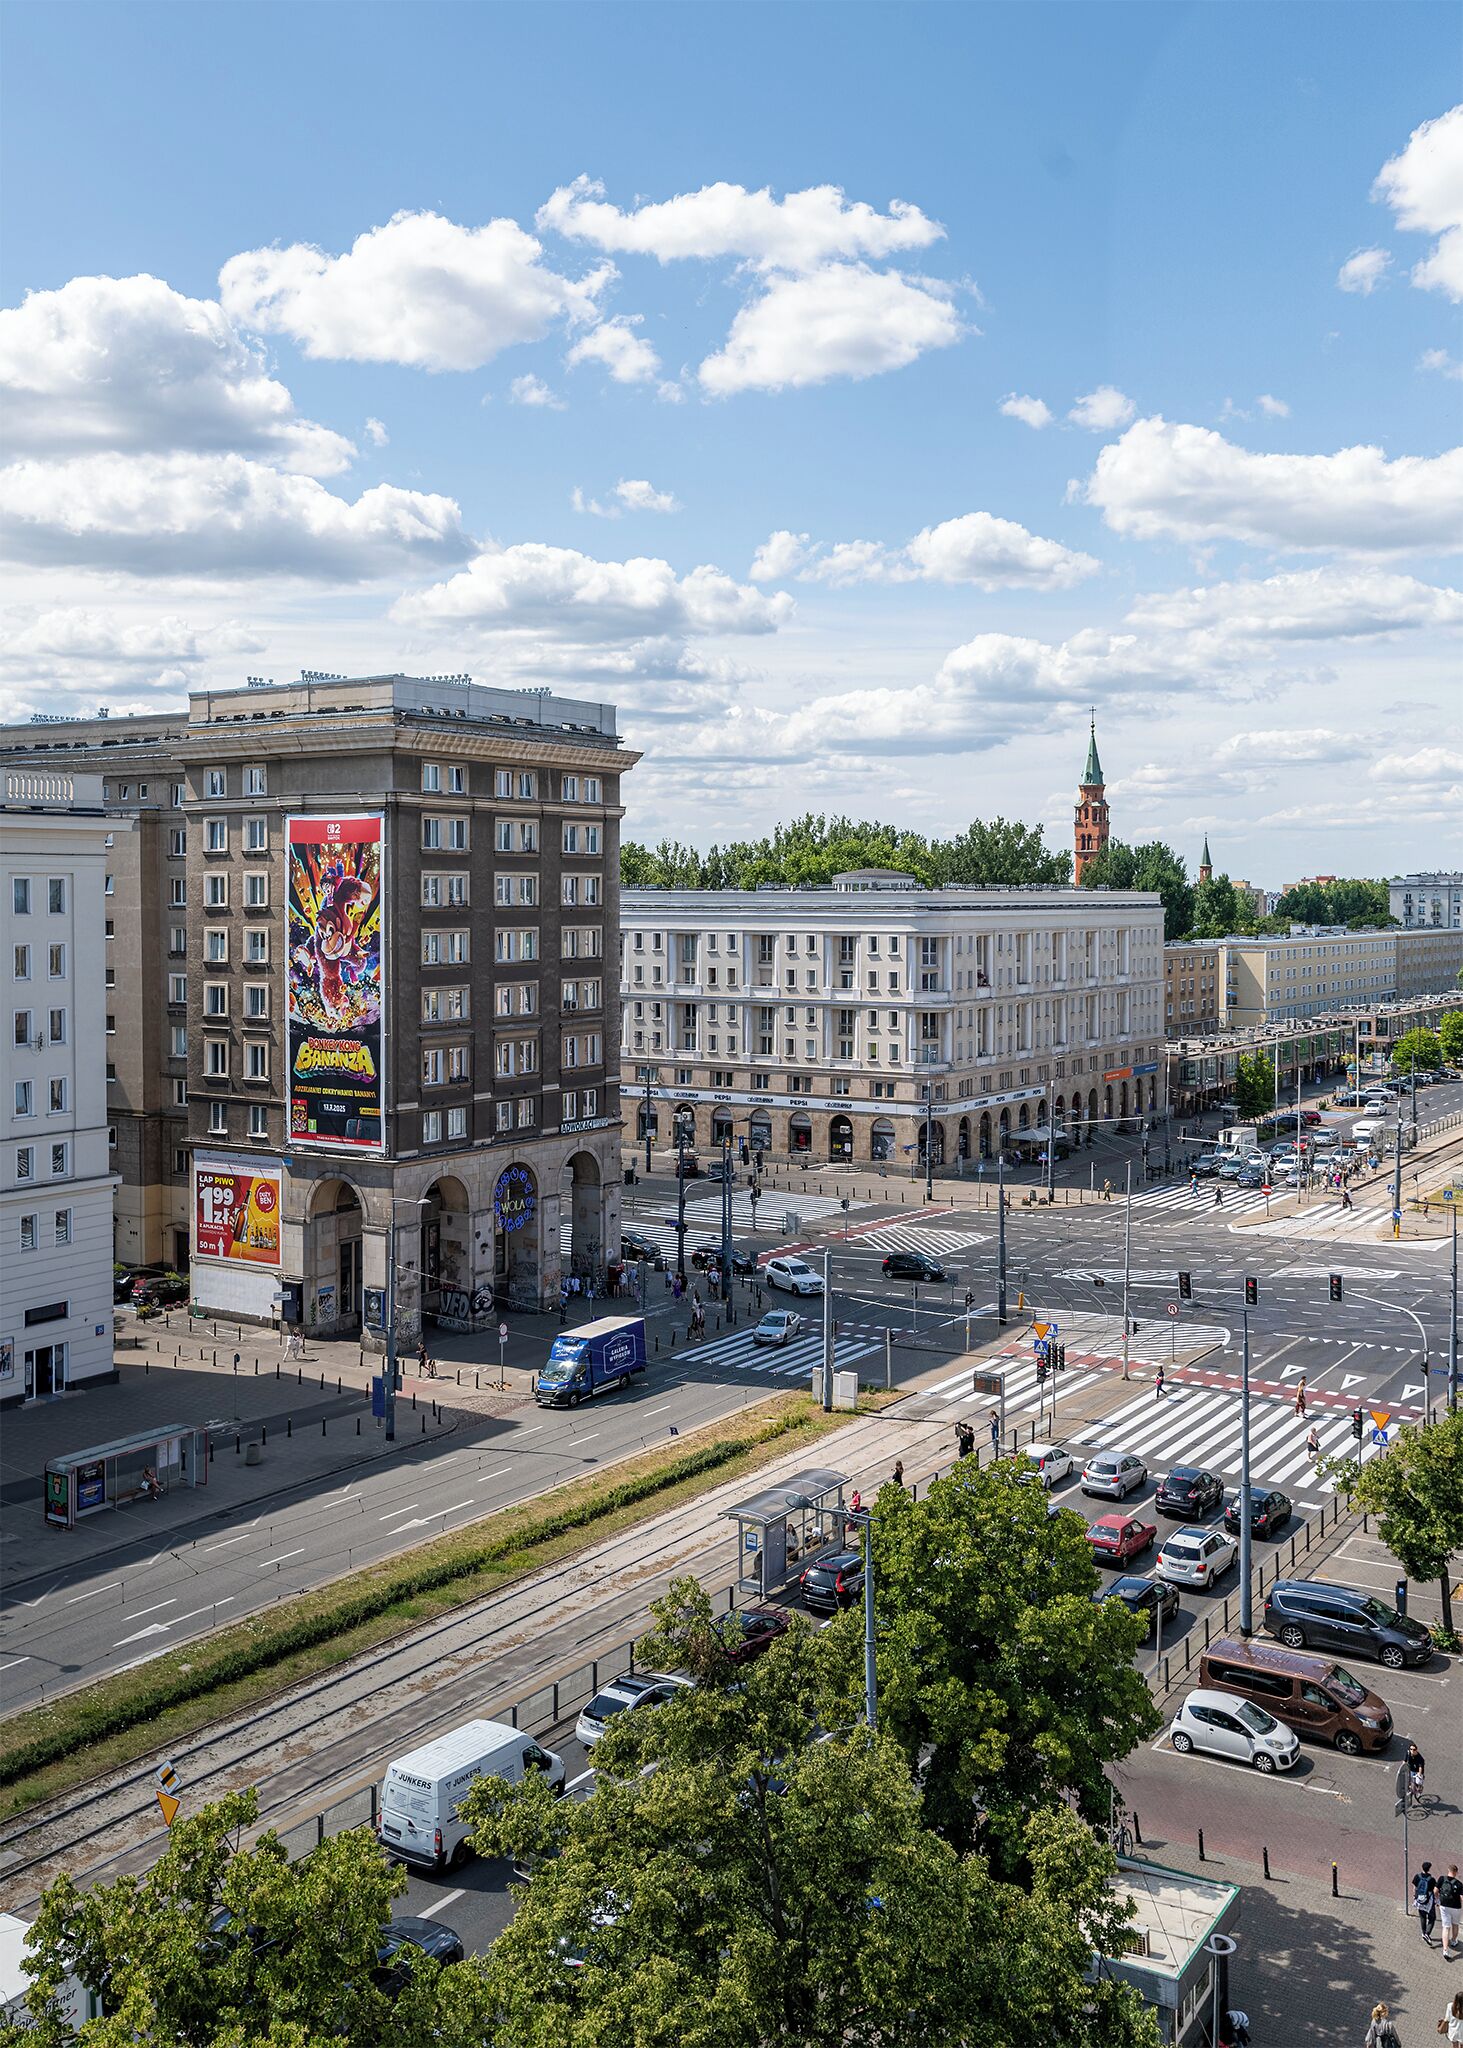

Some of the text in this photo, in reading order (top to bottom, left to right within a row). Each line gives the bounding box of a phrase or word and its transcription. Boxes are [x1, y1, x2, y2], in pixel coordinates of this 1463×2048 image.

[308, 1036, 361, 1052] DONKEY KONG
[296, 1042, 375, 1077] BANANZA
[789, 1099, 808, 1107] PEPSI
[199, 1174, 235, 1186] ŁAP PIWO
[501, 1199, 526, 1214] WOLA
[200, 1240, 208, 1249] 50
[398, 1773, 432, 1790] JUNKERS
[453, 1766, 481, 1787] JUNKERS
